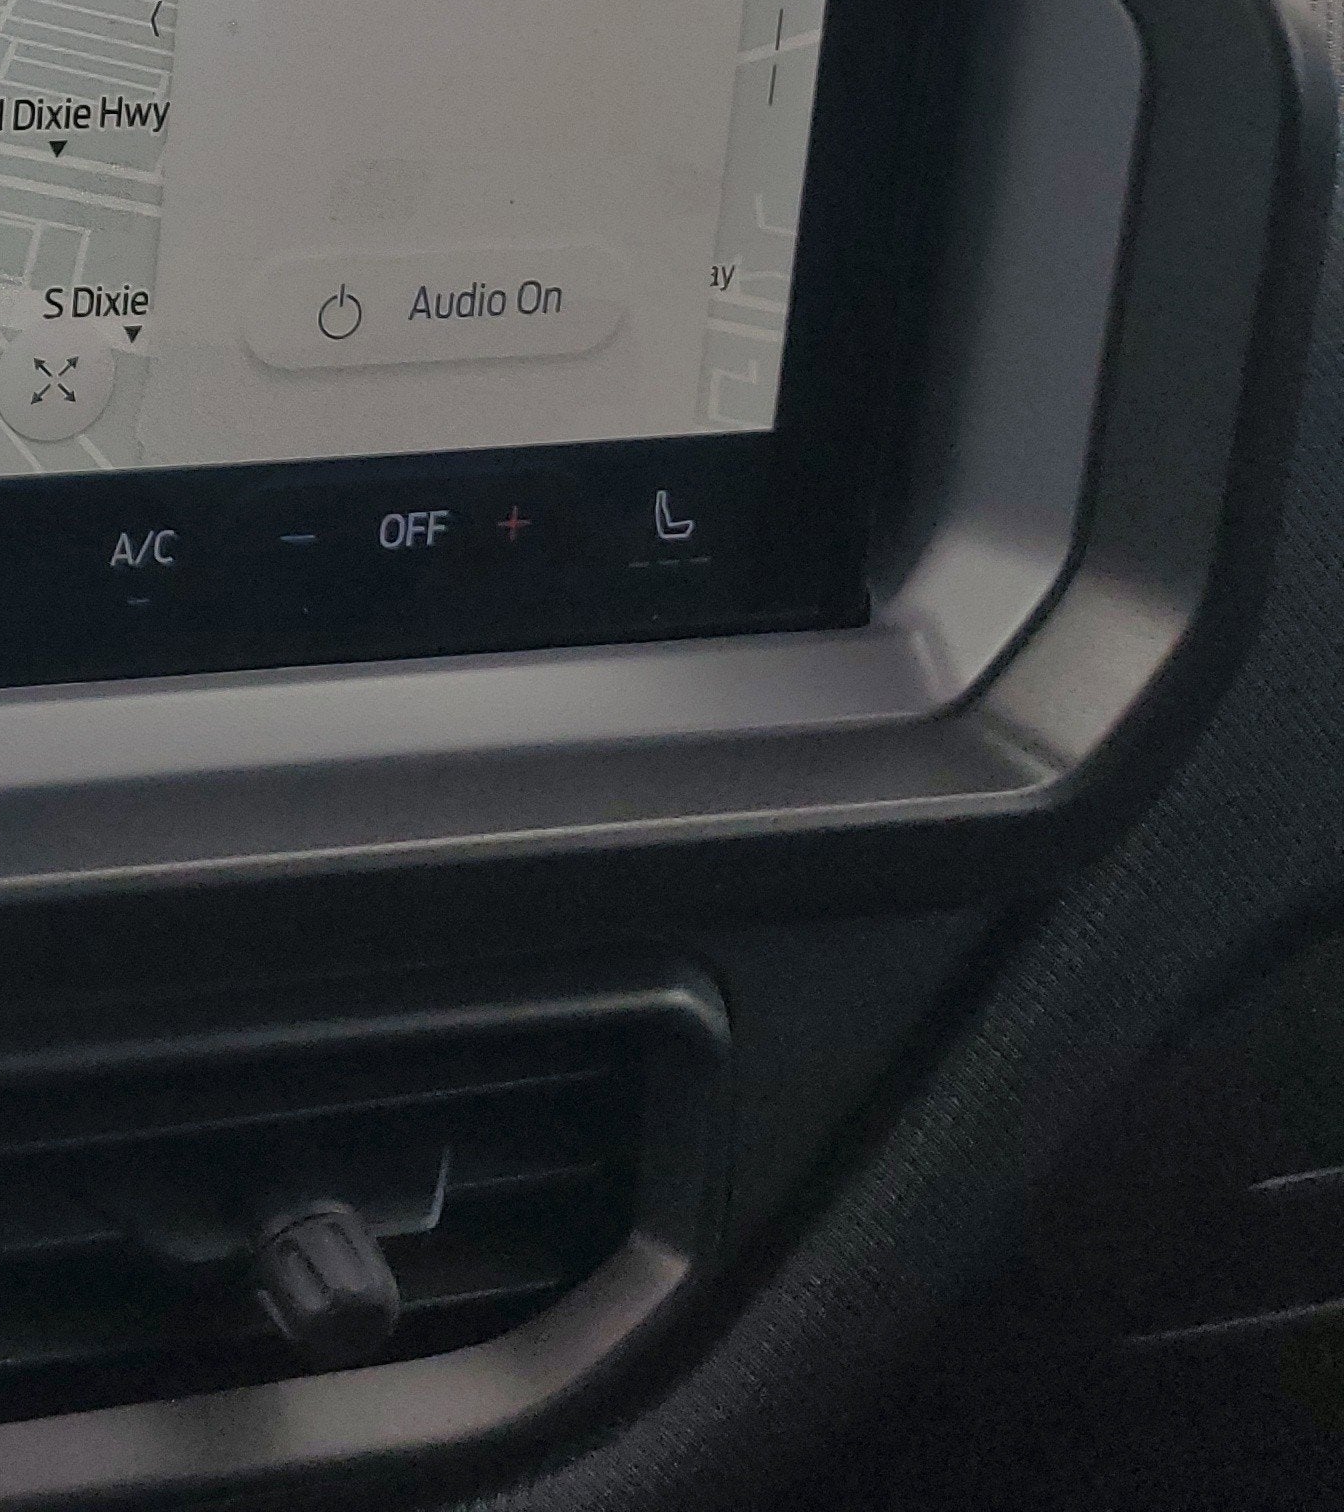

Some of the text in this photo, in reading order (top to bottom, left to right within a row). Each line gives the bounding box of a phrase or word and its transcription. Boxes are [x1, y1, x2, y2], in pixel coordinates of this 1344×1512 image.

[13, 98, 92, 133] Dixie
[100, 97, 170, 135] Hwy
[43, 287, 150, 320] S Dixie
[409, 282, 563, 322] Audio On
[111, 530, 175, 566] A/C
[379, 510, 448, 548] OFF
